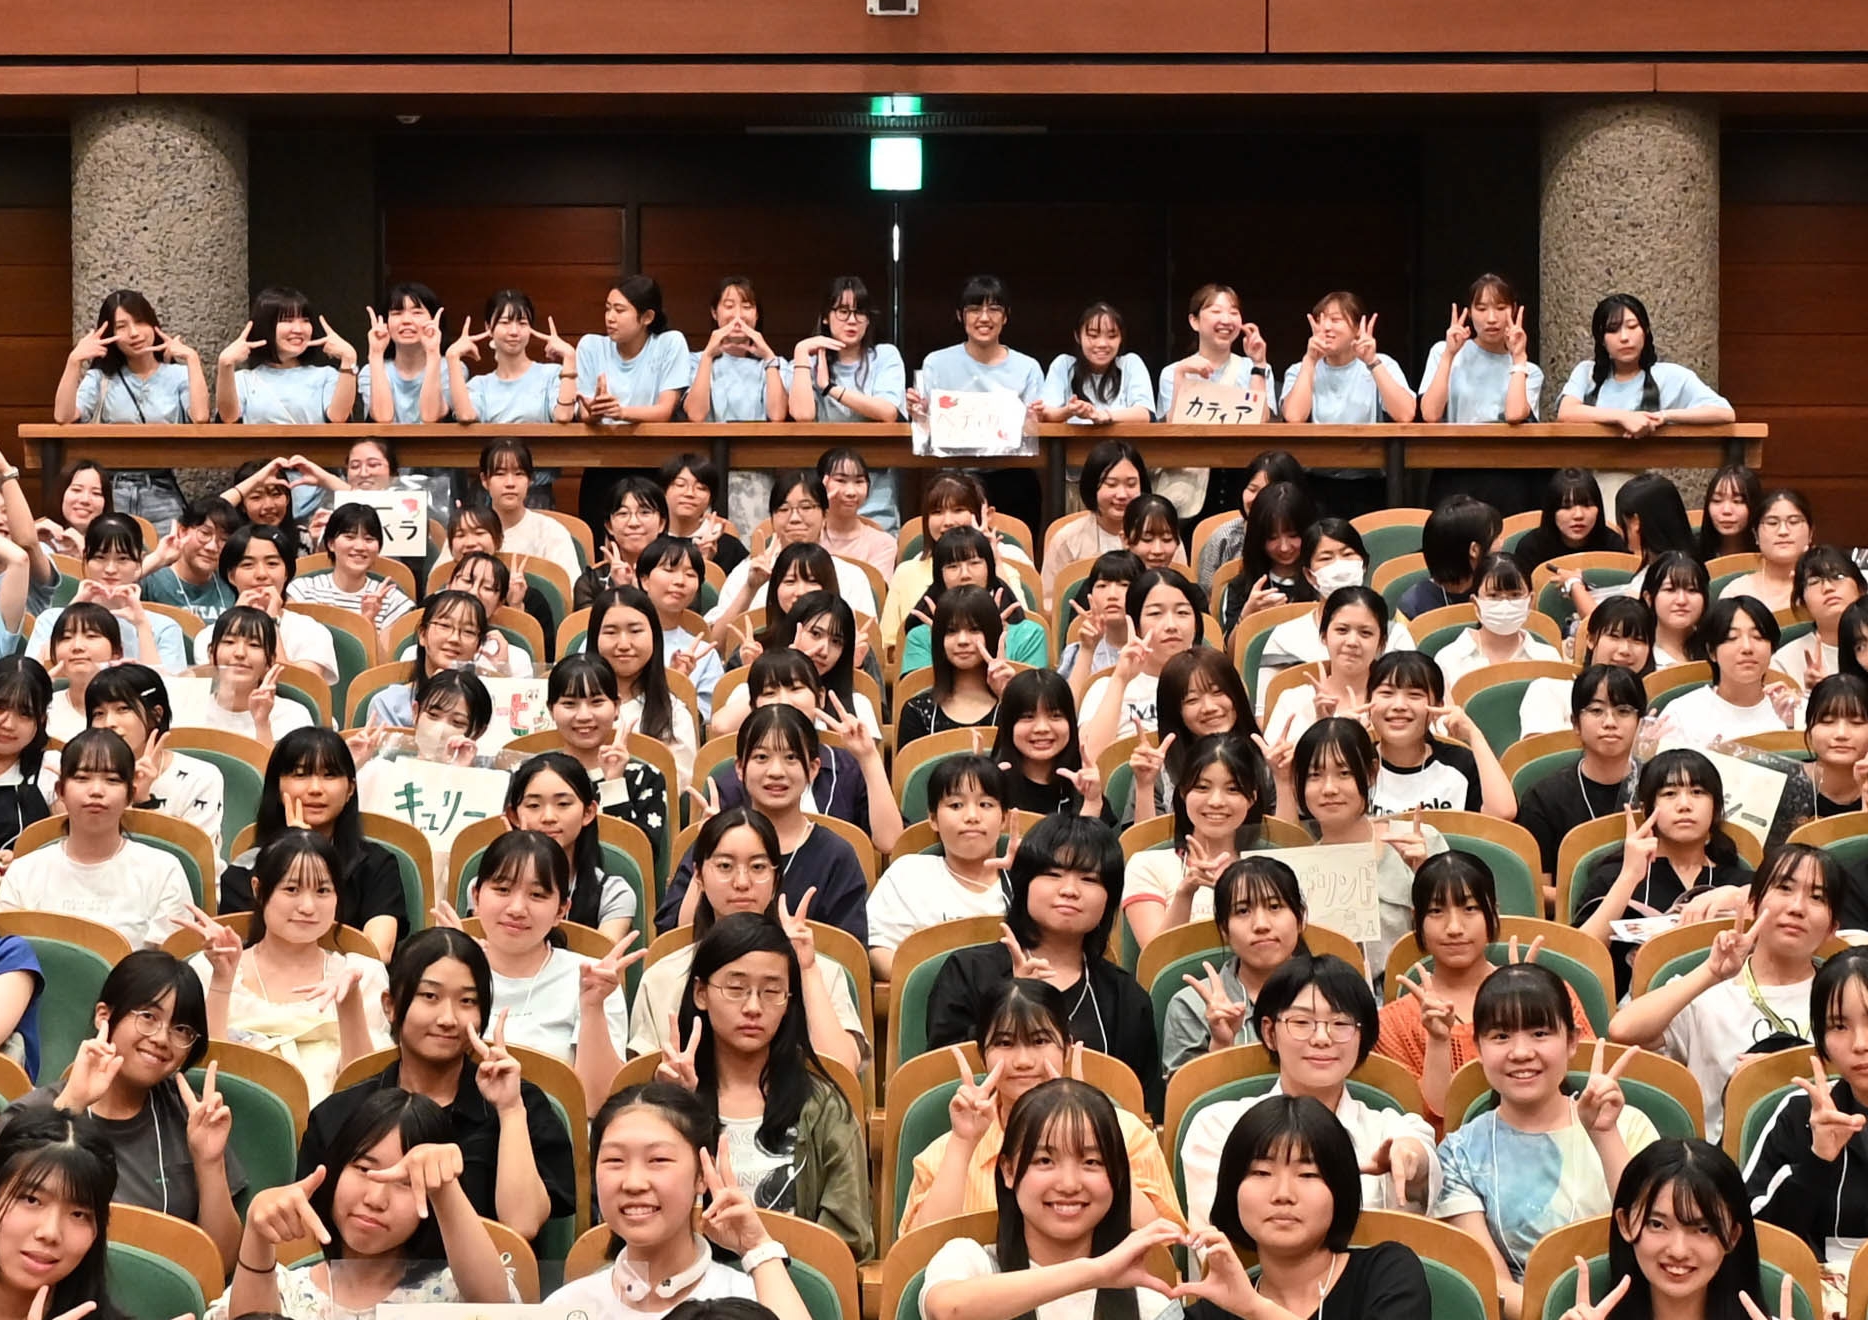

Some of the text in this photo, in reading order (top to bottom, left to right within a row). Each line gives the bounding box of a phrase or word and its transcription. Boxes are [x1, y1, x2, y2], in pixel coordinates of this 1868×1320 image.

[1185, 395, 1254, 424] カティア
[393, 781, 487, 837] キュリー
